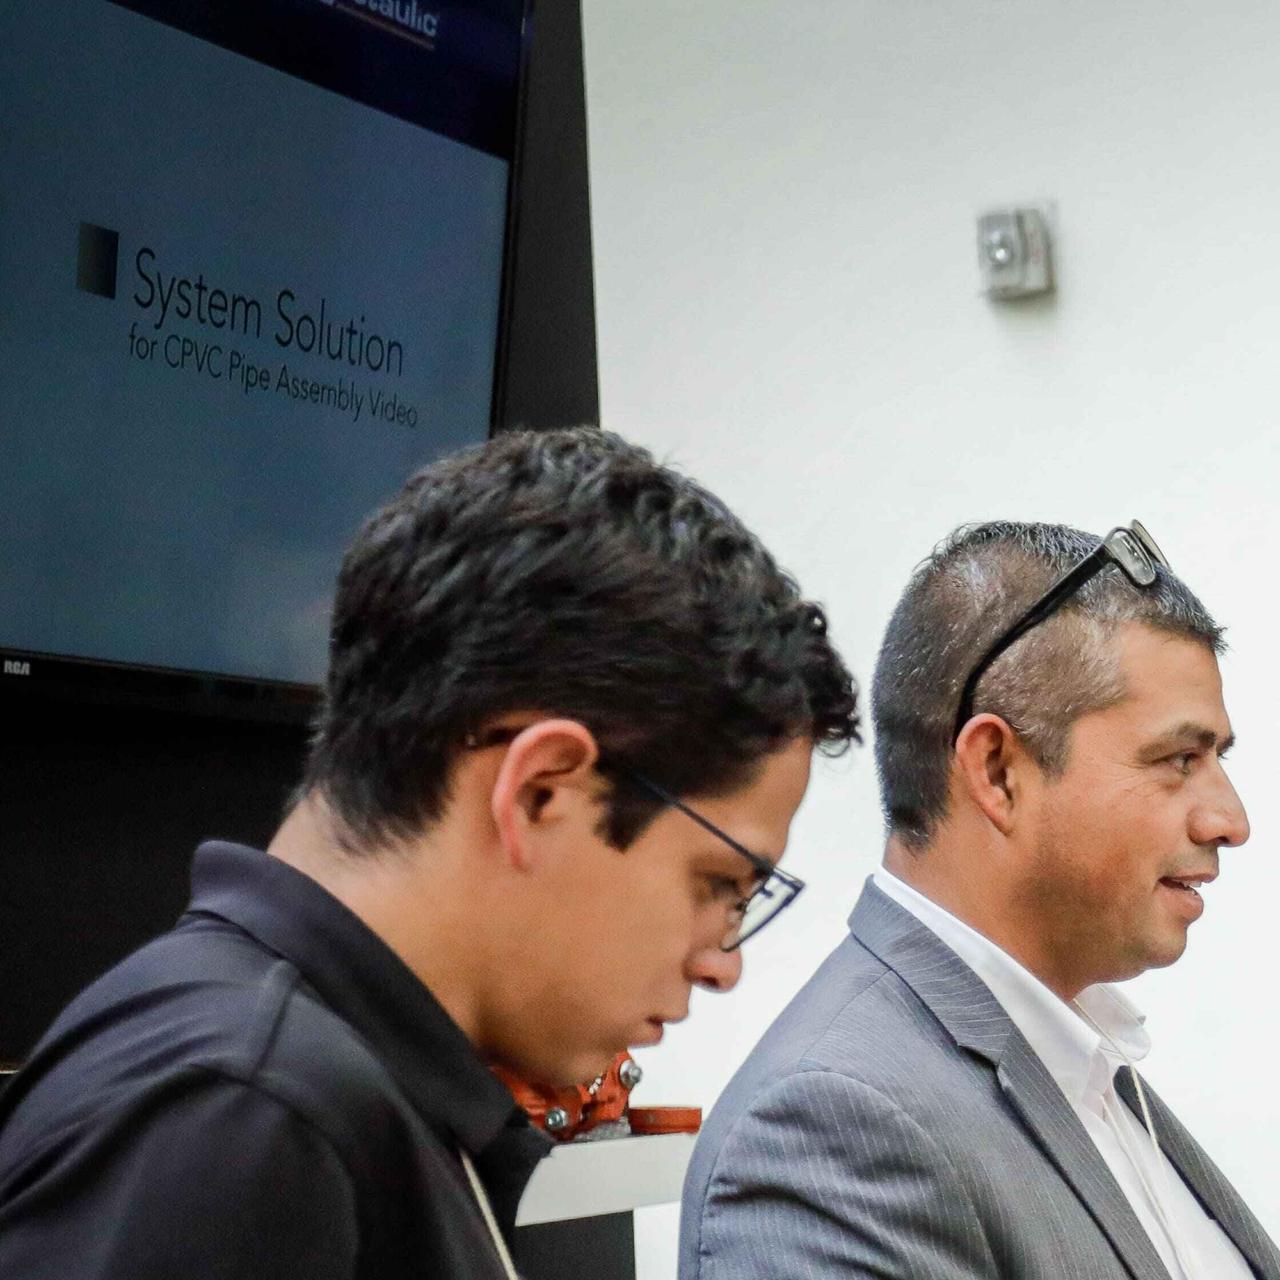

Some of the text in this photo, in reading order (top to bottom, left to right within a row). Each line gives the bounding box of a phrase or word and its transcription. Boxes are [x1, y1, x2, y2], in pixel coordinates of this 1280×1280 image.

[134, 247, 403, 377] System Solution
[129, 322, 418, 428] for CPVC Pipe Assembly Video
[4, 660, 30, 676] RCA
